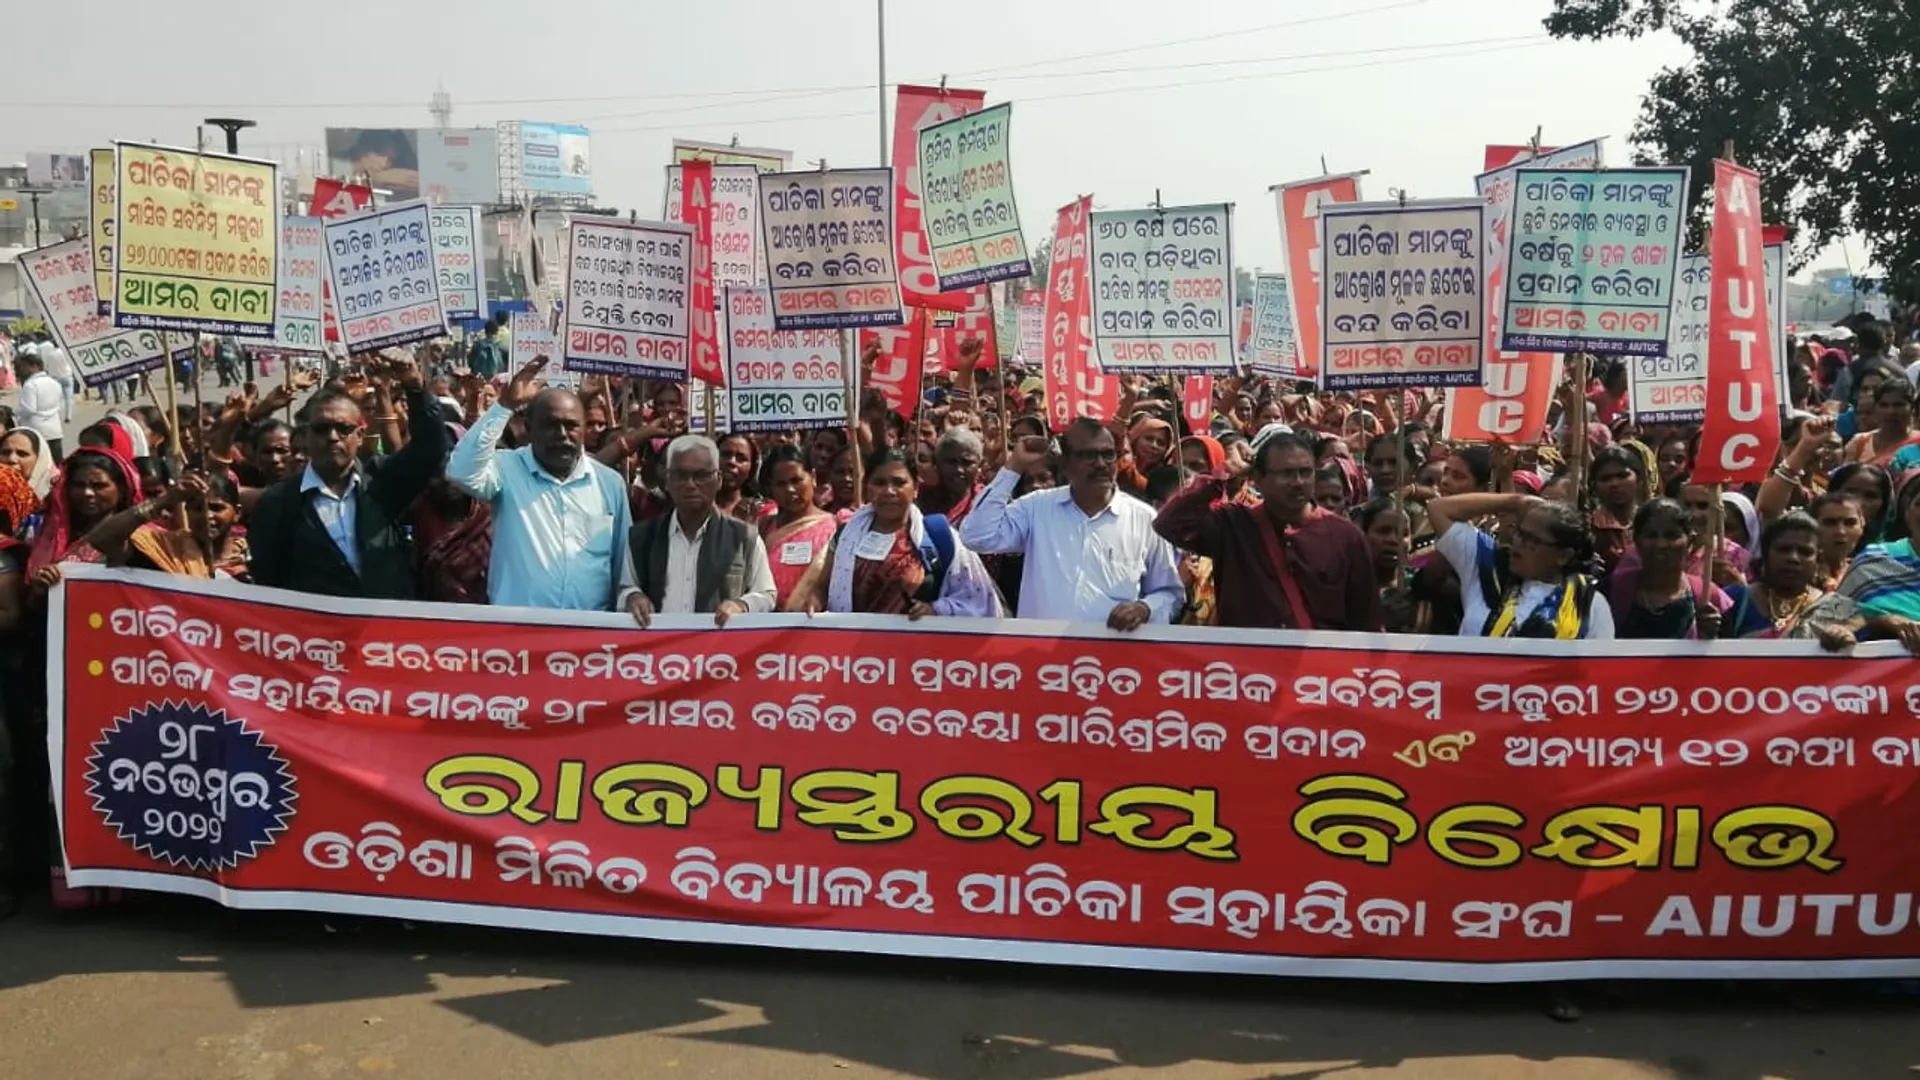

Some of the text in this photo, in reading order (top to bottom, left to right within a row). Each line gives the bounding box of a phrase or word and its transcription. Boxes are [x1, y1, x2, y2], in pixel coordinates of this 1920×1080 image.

[128, 155, 265, 206] ପାଚିକା ମାନଙ୍କୁ
[1526, 177, 1594, 202] ପାଚିକା
[1604, 184, 1673, 208] ମାନଙ୍କୁ
[769, 182, 884, 212] ପାଚିକା ମାନଙ୍କୁ
[1173, 216, 1219, 236] ପରେ
[1656, 214, 1668, 232] ଓ
[333, 230, 377, 256] ପାଚିକା
[1334, 224, 1474, 259] ପାଚିକା ମାନଙ୍କୁ
[1520, 236, 1574, 268] ବର୍ଷକୁ
[823, 253, 886, 277] କରିବା
[125, 279, 268, 314] ଆମର ଦାବୀ
[389, 278, 431, 300] କରିବା
[1517, 273, 1582, 297] ପ୍ରଦାନ
[1592, 269, 1661, 297] କରିବା
[780, 288, 893, 310] ଆମର ଦାବୀ
[631, 311, 673, 327] ଦେବା
[1102, 303, 1222, 332] ପ୍ରଦାନ କରିବା
[1391, 305, 1469, 331] କରିବା
[1515, 308, 1659, 333] ଆମର ଦାବୀ
[1720, 176, 1763, 470] AIUTUC
[78, 339, 138, 368] ଆମର
[572, 330, 627, 358] ଆମର
[637, 338, 683, 362] ଦାବୀ
[1111, 342, 1217, 361] ଆମର ଦାବୀ
[1334, 345, 1472, 368] ଆମର ଦାବୀ
[736, 362, 785, 384] ପ୍ରଦାନ
[738, 393, 794, 415] ଆମର
[110, 605, 222, 649] ପାଚିକା
[234, 627, 349, 672] ମାନଙ୍କୁ
[362, 640, 530, 676] ସରକାରୀ
[755, 653, 896, 685] ମାନ୍ୟତା
[911, 659, 1022, 692] ପ୍ରଦାନ
[1037, 656, 1142, 701] ସହିତ
[1158, 662, 1277, 702] ମାସିକ
[1294, 667, 1442, 720] ସର୍ବନିମ୍ନ
[111, 650, 214, 691] ପାଚିକା
[227, 674, 392, 716] ସହାୟିକା
[406, 690, 531, 730] ମାନଙ୍କୁ
[543, 699, 608, 725] ୨୮
[624, 699, 736, 730] ମାସର
[872, 707, 1020, 742] ବକେୟା
[1035, 706, 1227, 752] ପାରିଶ୍ରମିକ
[1244, 724, 1366, 759] ପ୍ରଦାନ
[1393, 730, 1476, 768] ଏବଂ
[1503, 736, 1664, 769] ଅନ୍ୟାନ୍ୟ
[1679, 737, 1749, 768] ୧୨
[1765, 736, 1855, 769] ଦଫା
[158, 721, 215, 762] ୨୮
[108, 758, 272, 822] ନଭେମ୍ବର
[144, 809, 222, 844] ୨୦୨୨
[424, 754, 1846, 874] ରାଜ୍ୟସ୍ତରୀୟ ବିକ୍ଷୋଭ
[302, 821, 473, 883] ଓଡ଼ିଶା
[495, 835, 648, 894] ମିଳିତ
[671, 846, 934, 914] ବିଦ୍ୟାଳୟ
[958, 862, 1142, 923] ପାଚିକା
[1167, 879, 1426, 939] ସହାୟିକା
[1452, 900, 1572, 939] ସଂଘ
[1644, 892, 1920, 936] AIUTU
